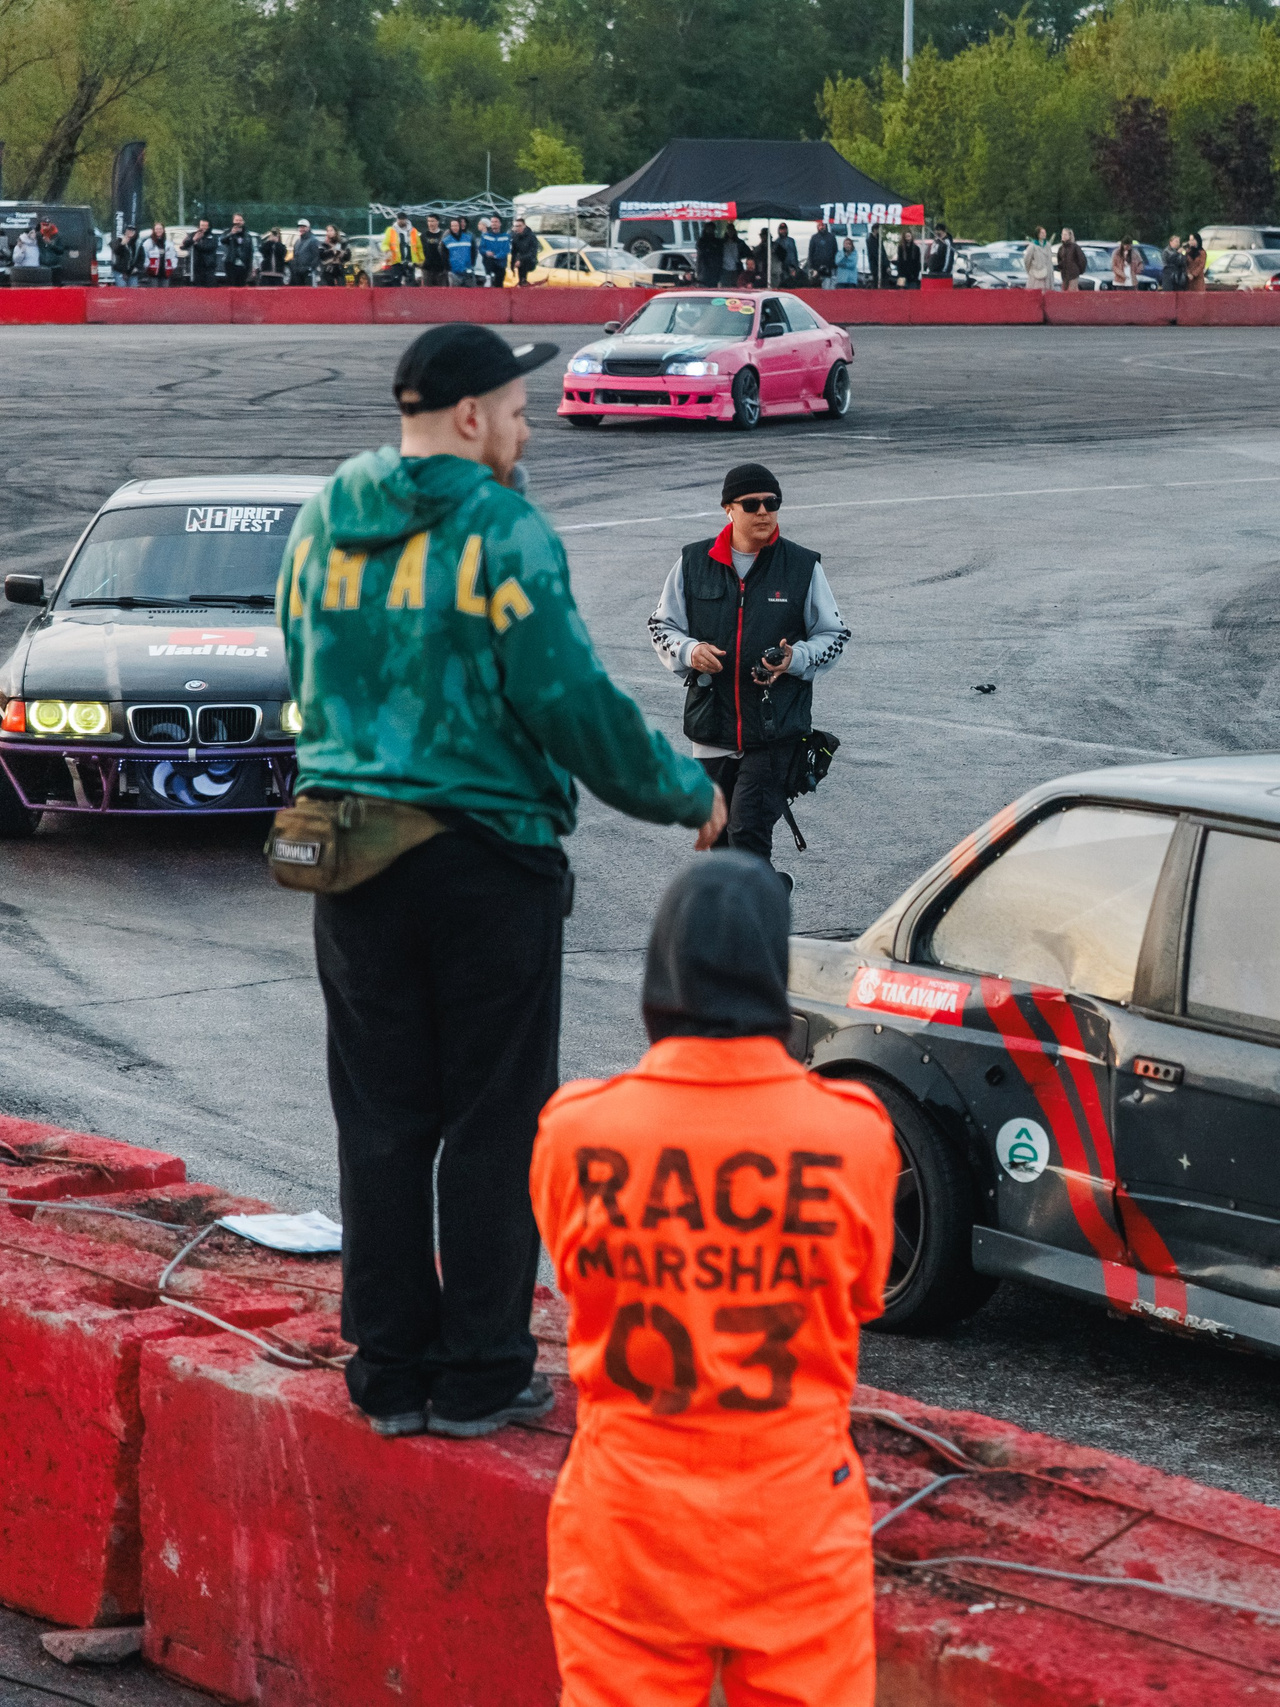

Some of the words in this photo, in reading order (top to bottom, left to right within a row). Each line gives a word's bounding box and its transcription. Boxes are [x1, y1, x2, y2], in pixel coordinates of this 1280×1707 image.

[231, 506, 284, 520] DRIFT
[229, 519, 275, 532] FEST
[148, 644, 213, 657] Vlad
[215, 645, 270, 658] Hot
[881, 982, 958, 1013] TAKAYAMA
[576, 1146, 844, 1237] RACE
[604, 1301, 807, 1416] 03
